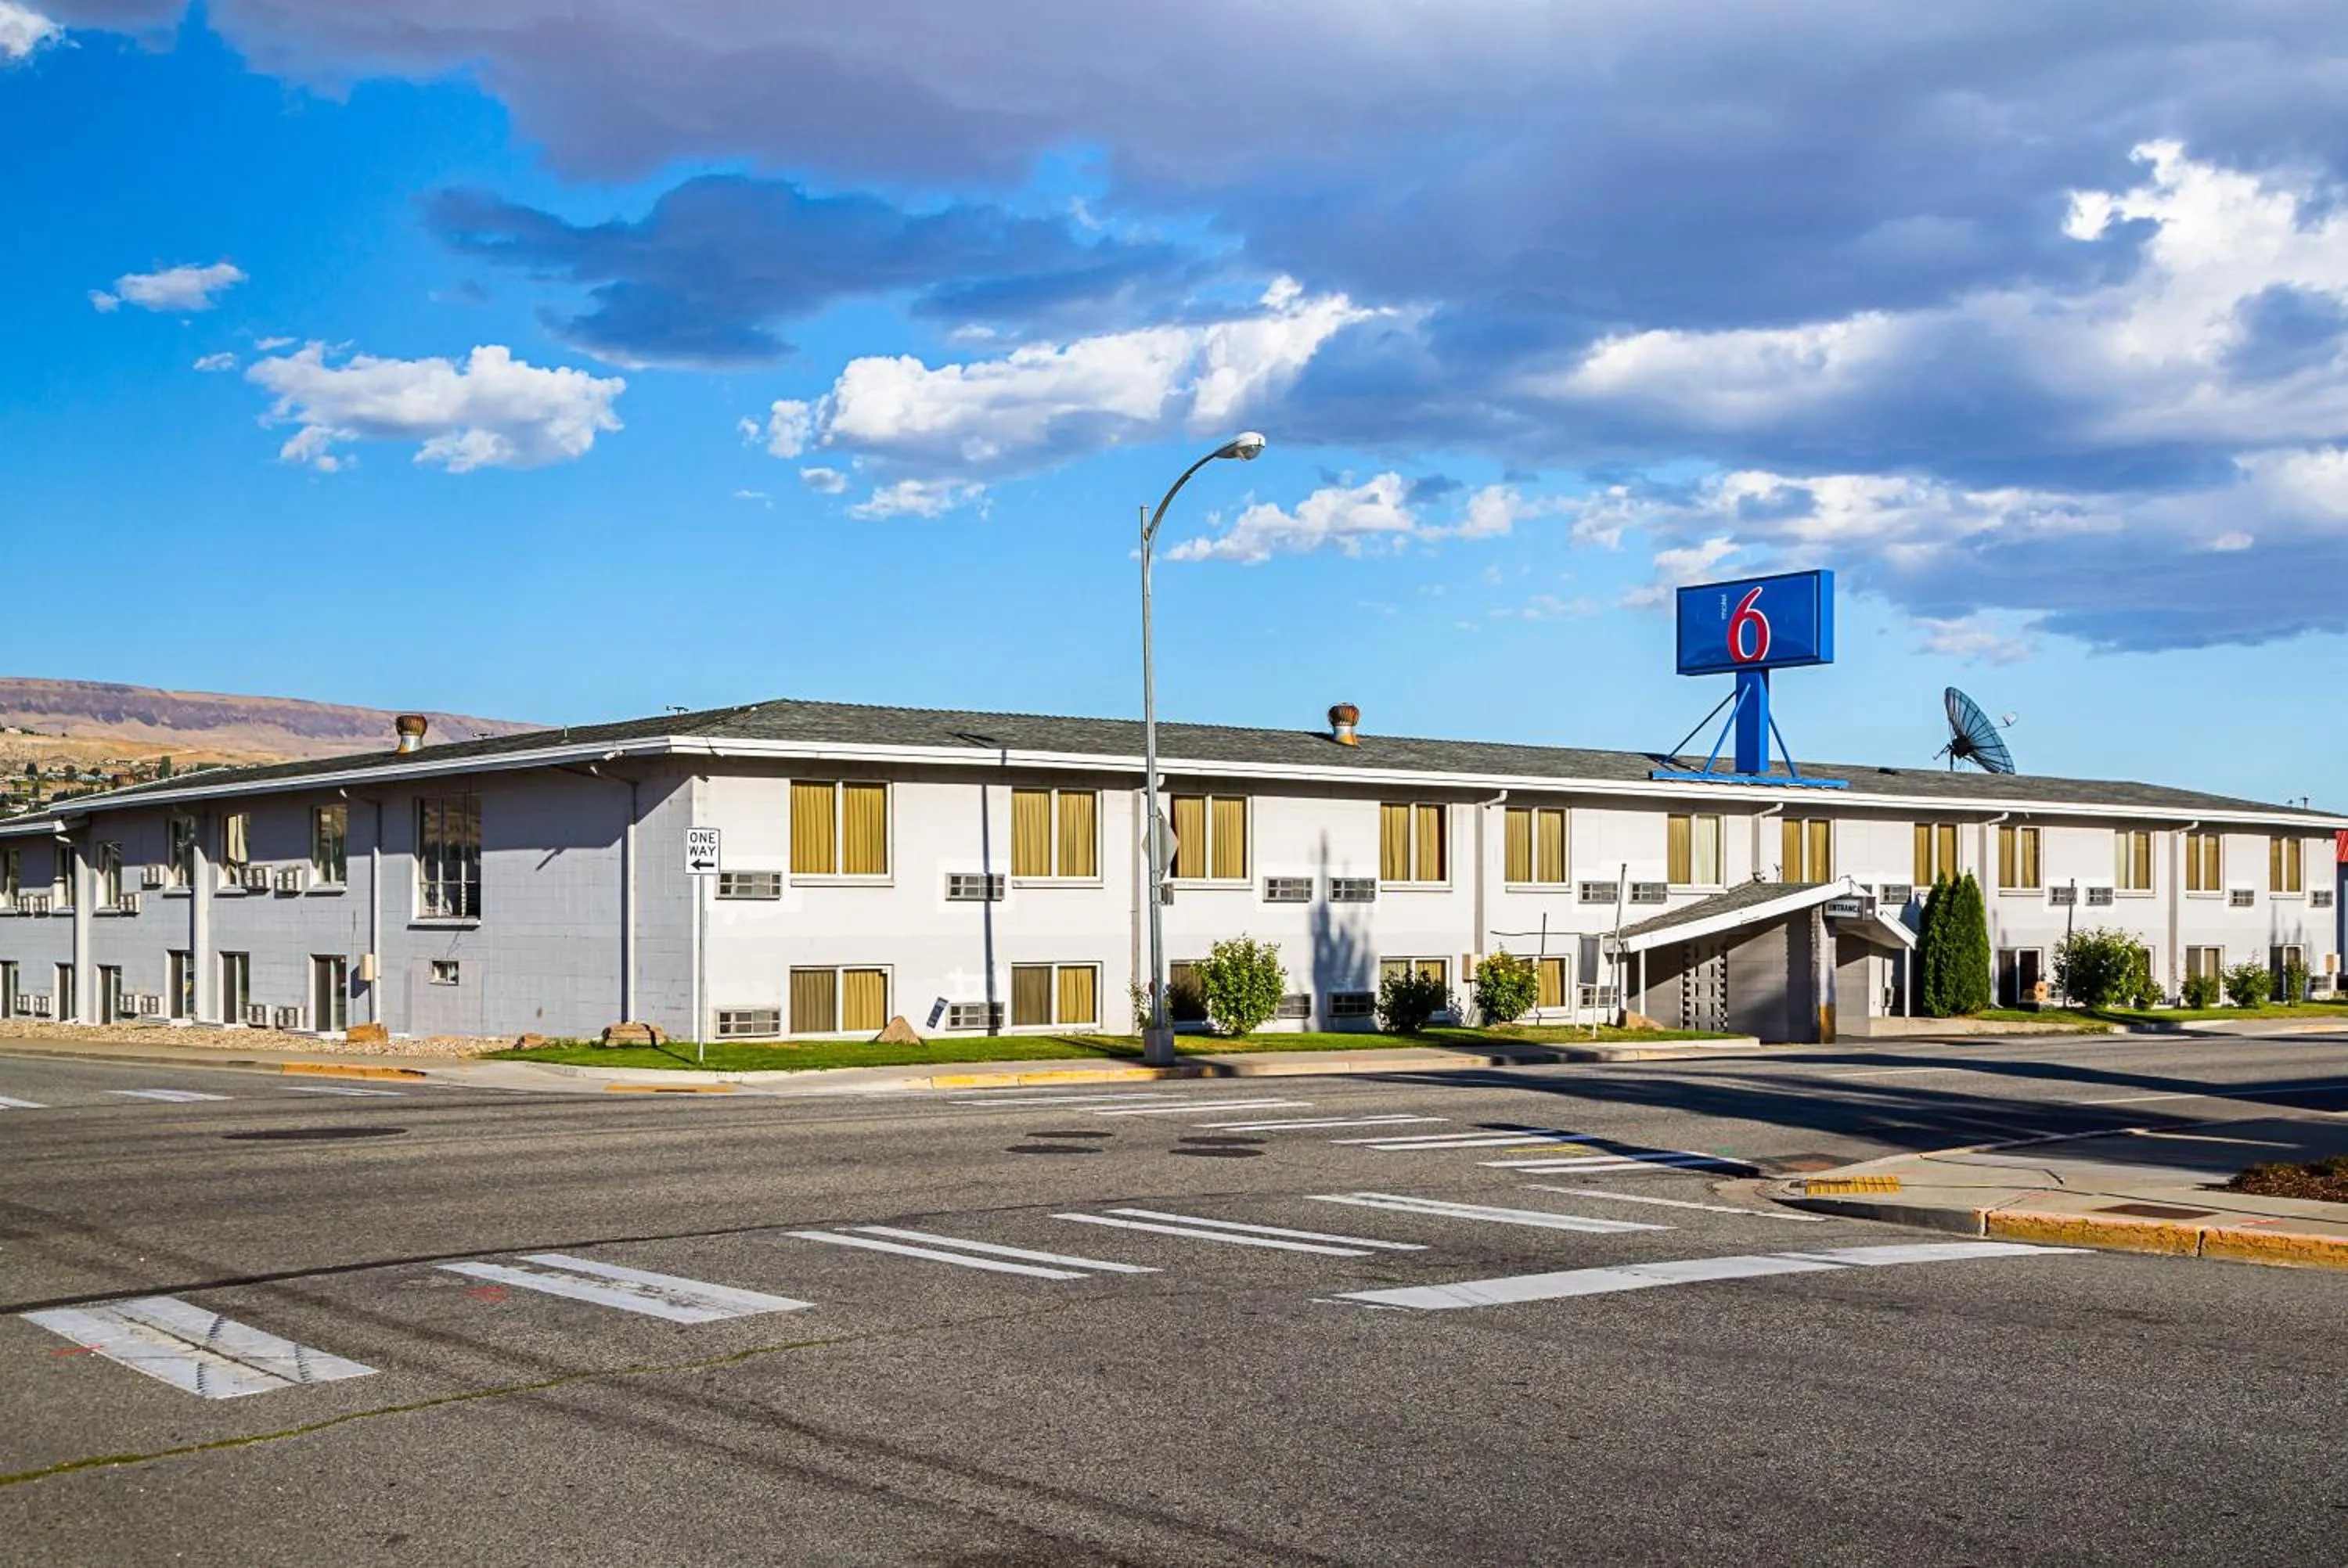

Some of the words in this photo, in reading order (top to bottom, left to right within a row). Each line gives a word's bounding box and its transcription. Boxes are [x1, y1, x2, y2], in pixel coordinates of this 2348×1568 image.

[1727, 586, 1770, 663] 6
[690, 832, 716, 843] ONE
[689, 845, 716, 857] WAY
